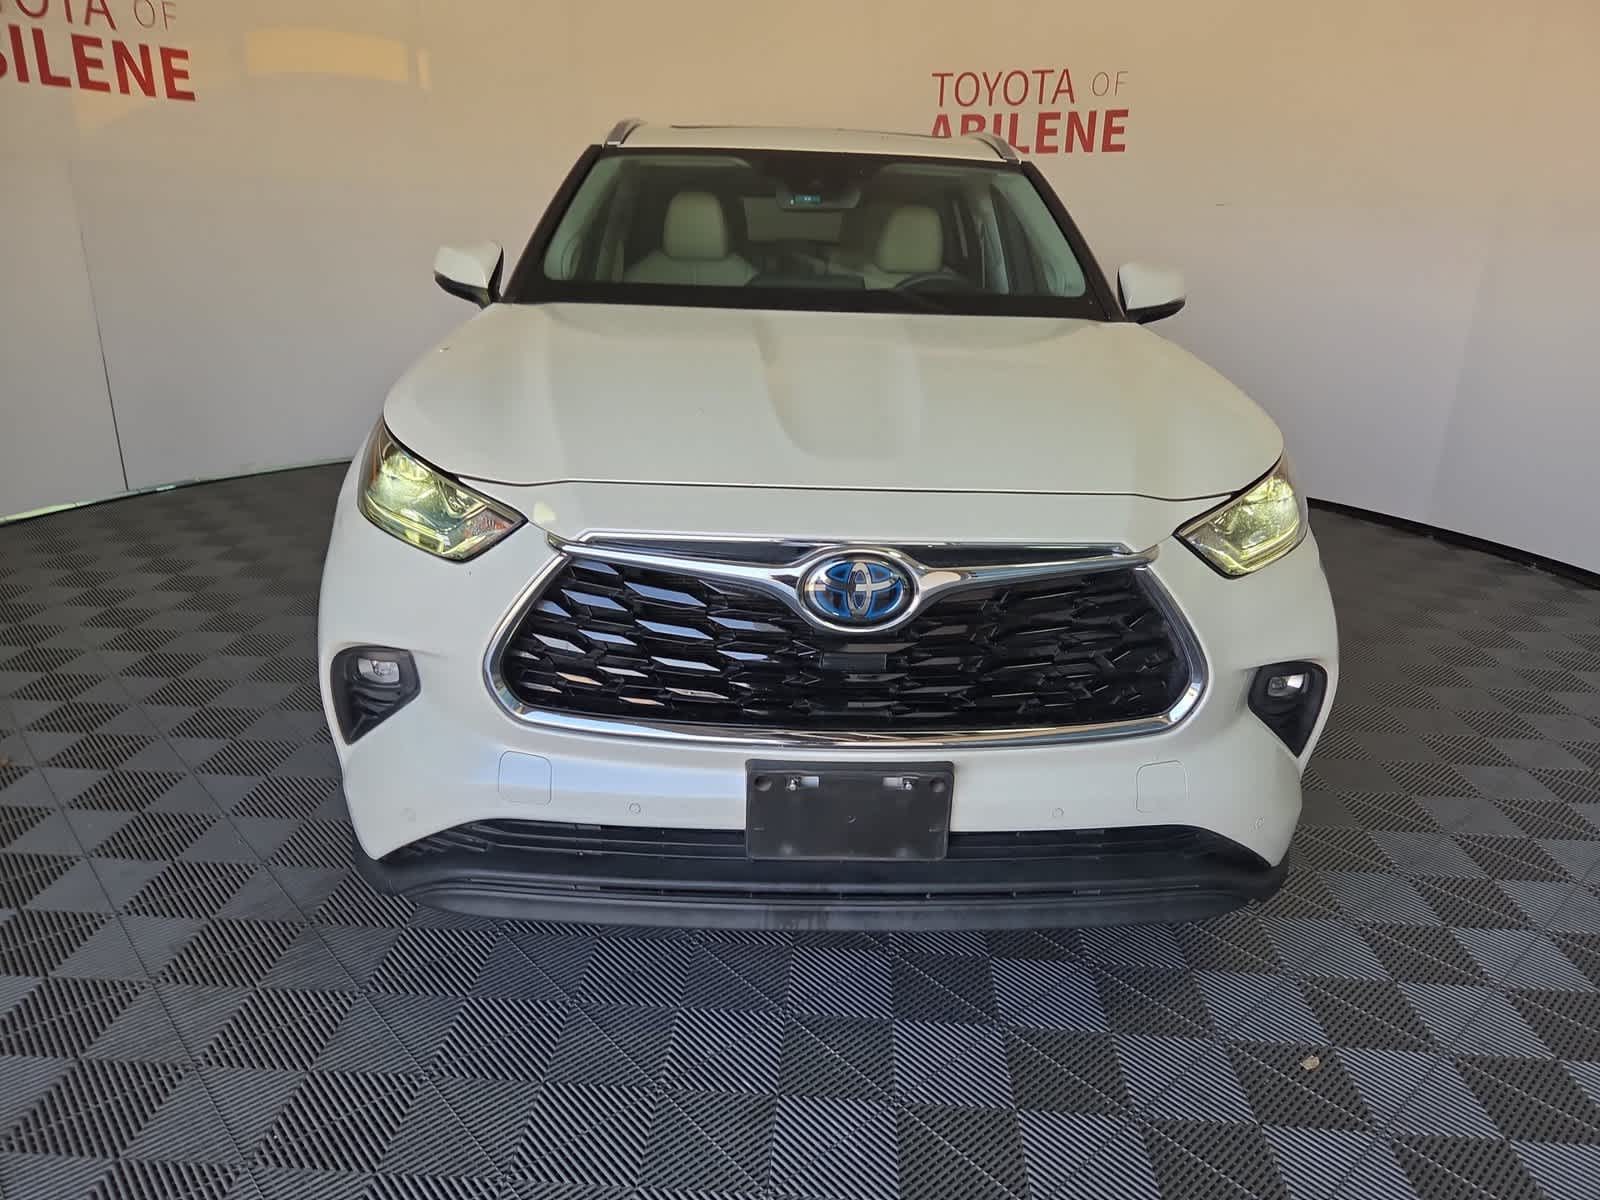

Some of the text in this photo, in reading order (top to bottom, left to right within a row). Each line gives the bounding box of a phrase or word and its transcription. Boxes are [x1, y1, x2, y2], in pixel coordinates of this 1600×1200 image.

[133, 0, 176, 30] OF
[931, 69, 1128, 107] TOYOTA OF
